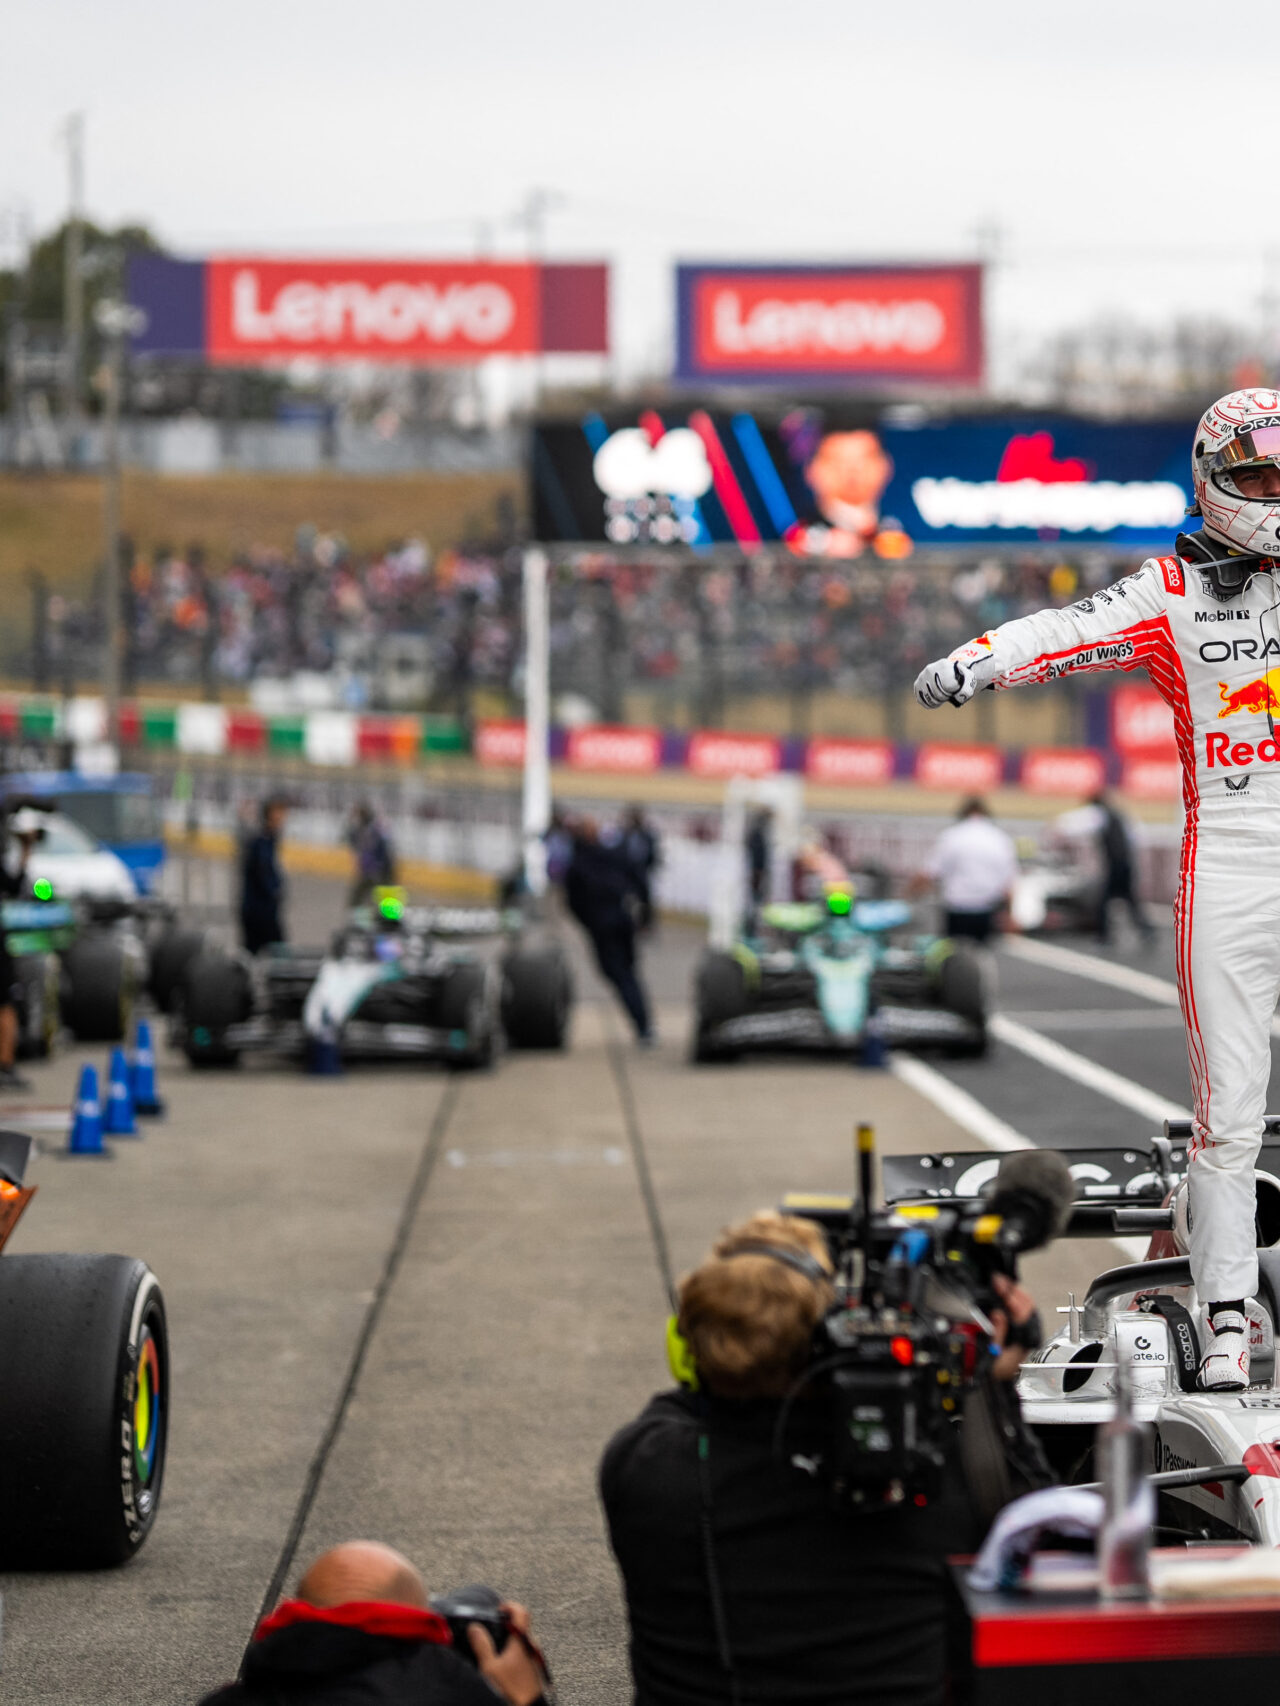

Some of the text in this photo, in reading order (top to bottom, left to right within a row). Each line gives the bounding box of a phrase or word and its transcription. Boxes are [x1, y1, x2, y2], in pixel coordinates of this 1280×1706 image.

[231, 268, 515, 343] Lenovo
[713, 292, 945, 354] Lenovo
[1195, 610, 1234, 622] Mobil
[1133, 1352, 1165, 1361] ate.io
[1177, 1323, 1195, 1371] sparco
